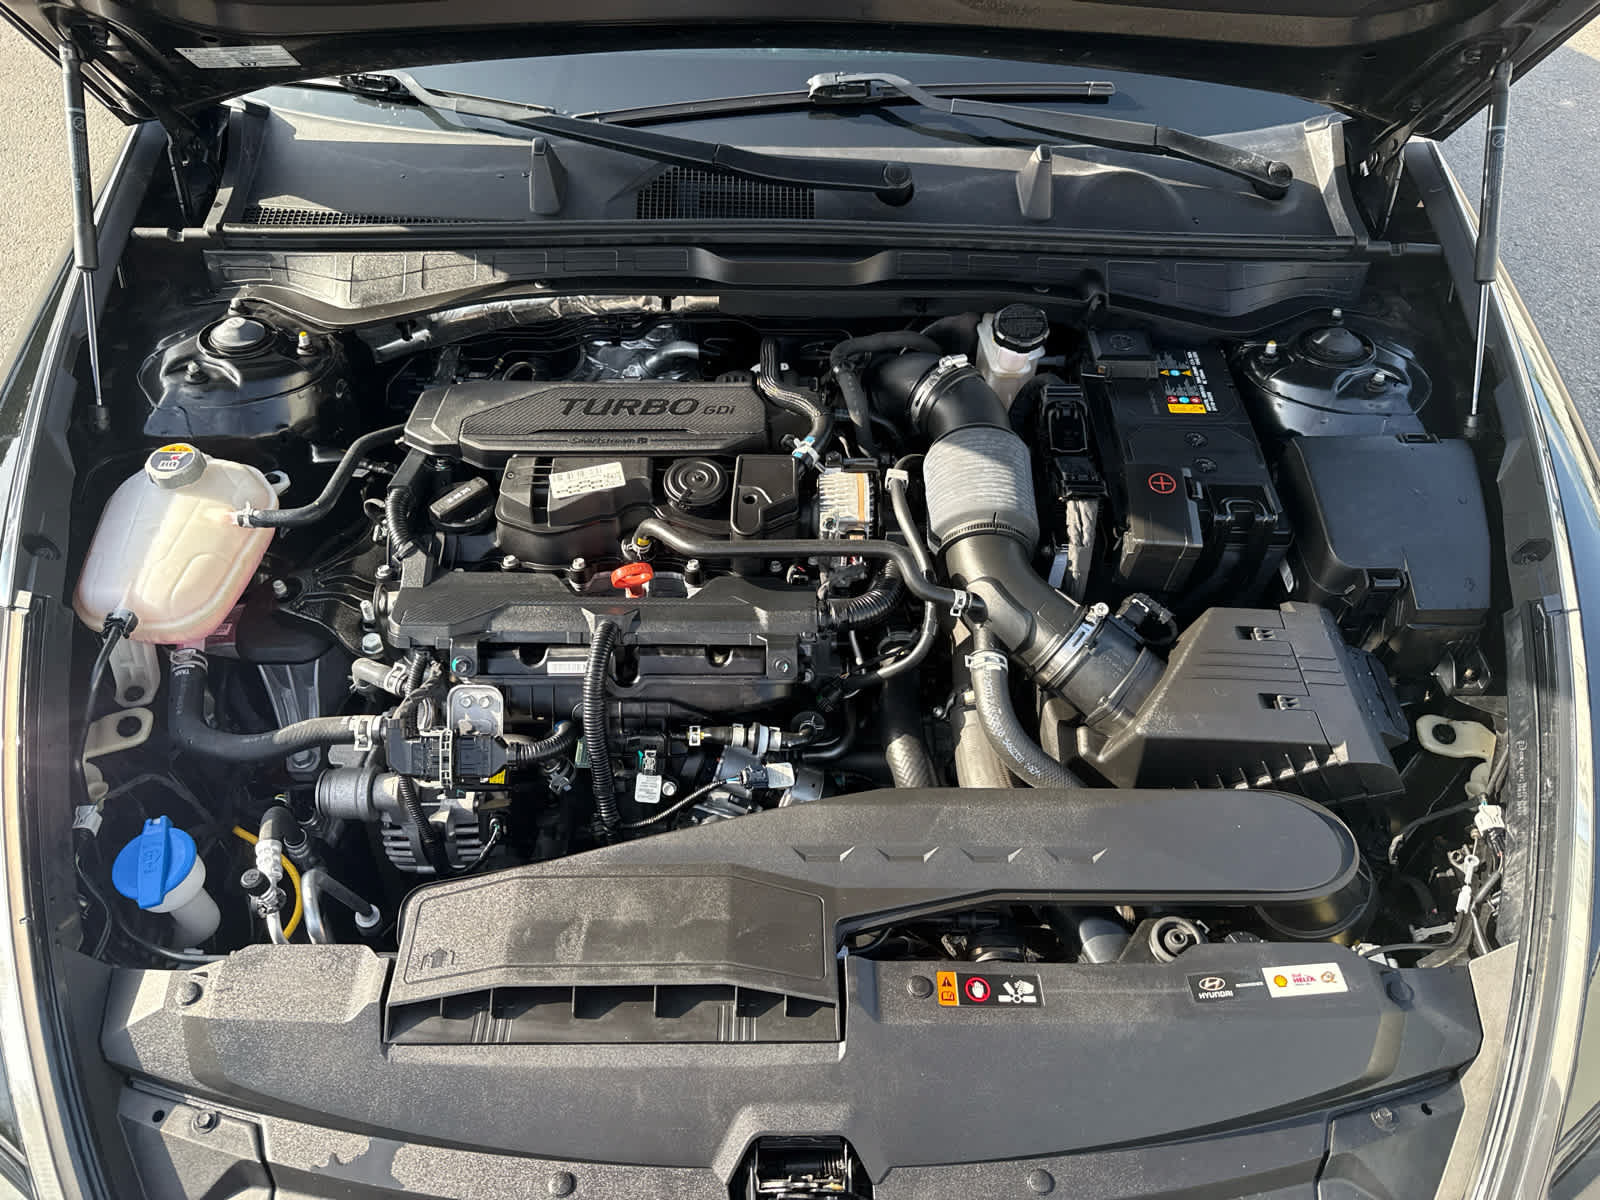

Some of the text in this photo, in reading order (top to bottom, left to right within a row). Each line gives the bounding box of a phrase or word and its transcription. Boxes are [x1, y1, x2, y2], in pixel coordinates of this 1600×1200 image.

[560, 398, 736, 416] TURBO GDi
[1198, 990, 1233, 999] HYUNDAI
